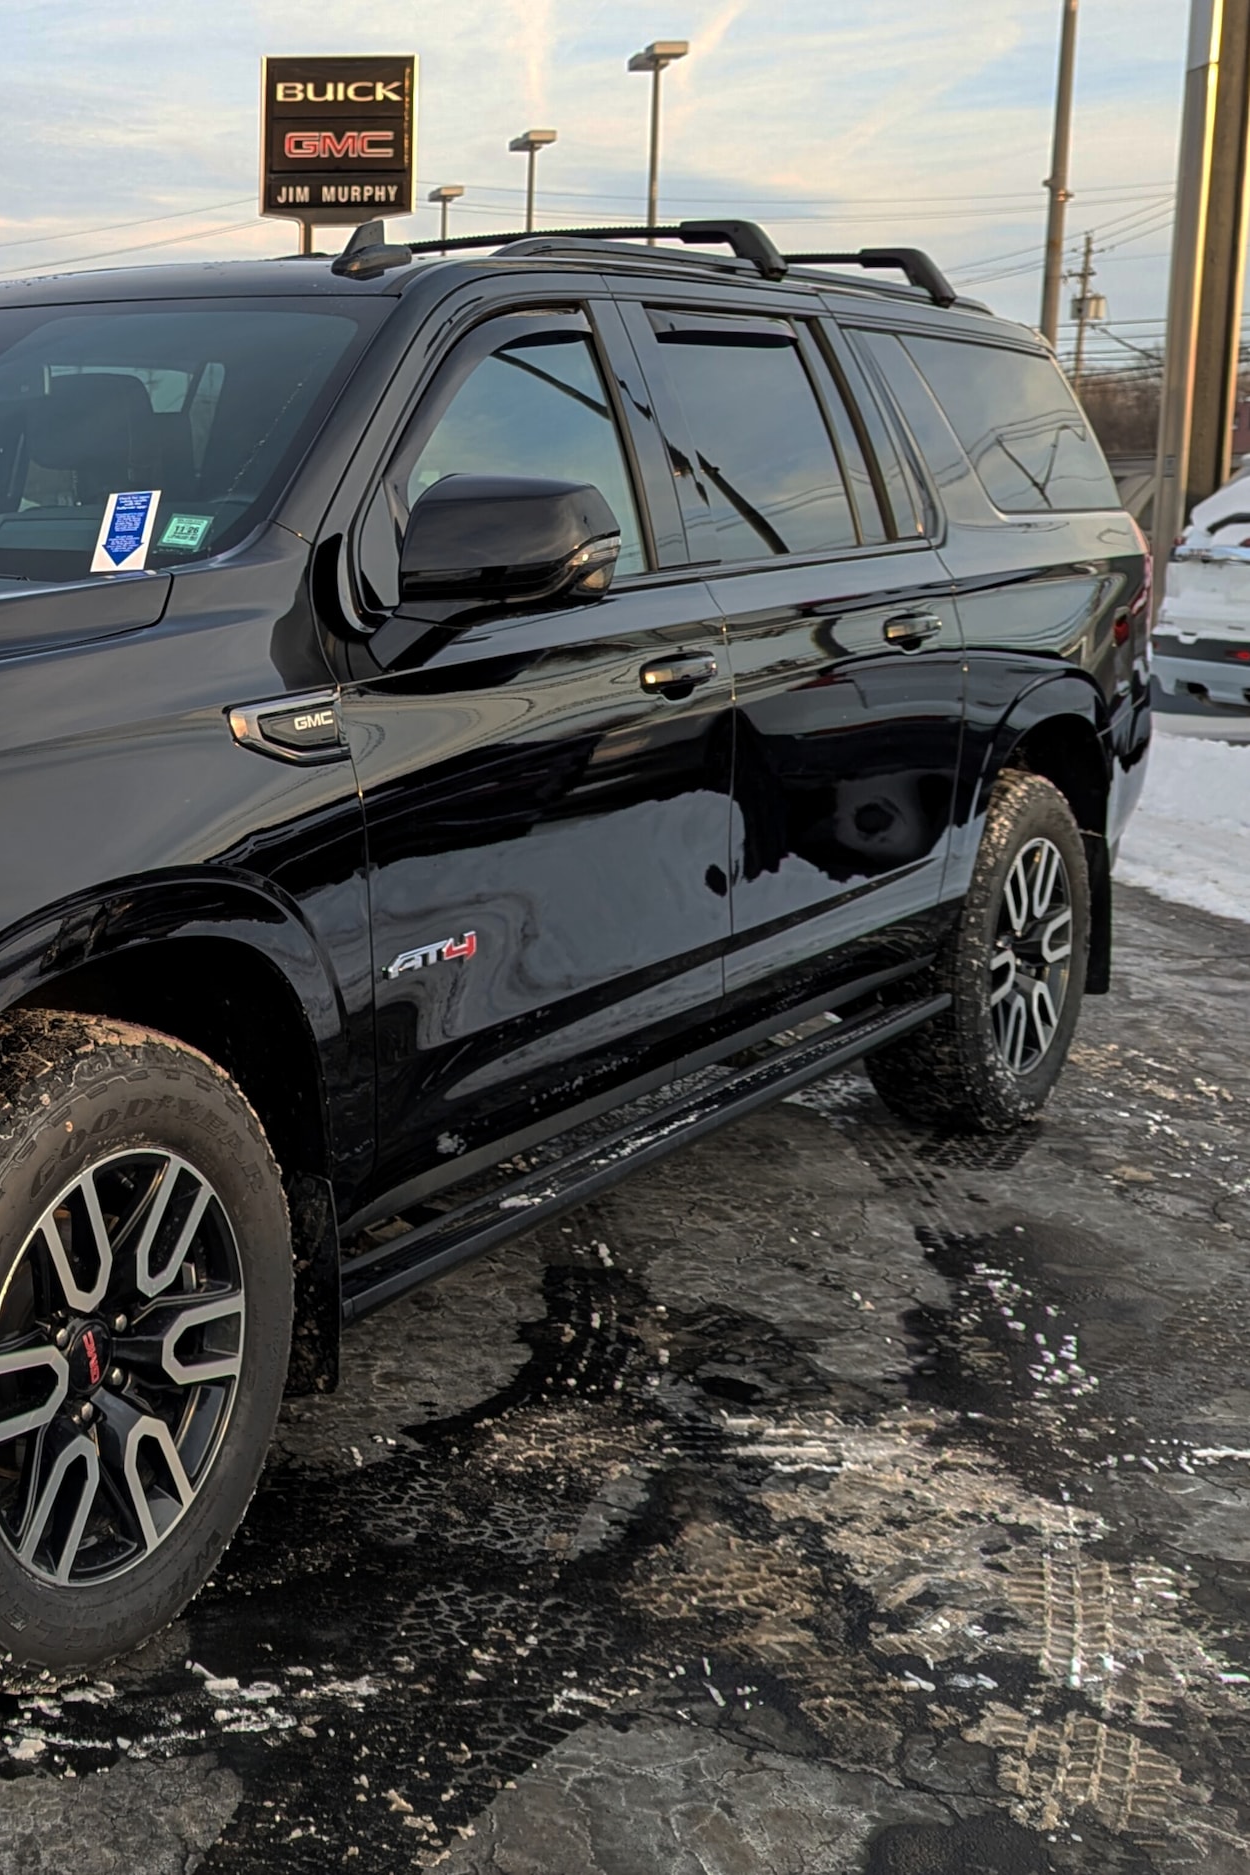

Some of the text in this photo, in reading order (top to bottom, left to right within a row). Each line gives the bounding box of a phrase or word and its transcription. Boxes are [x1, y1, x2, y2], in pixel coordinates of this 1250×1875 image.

[276, 82, 403, 102] BUICK
[284, 131, 395, 158] GMC
[276, 185, 398, 203] JIM MURPHY
[293, 710, 334, 731] GMC
[382, 930, 477, 979] AT4
[30, 1095, 268, 1199] GOODYEAR
[82, 1330, 100, 1386] GMC
